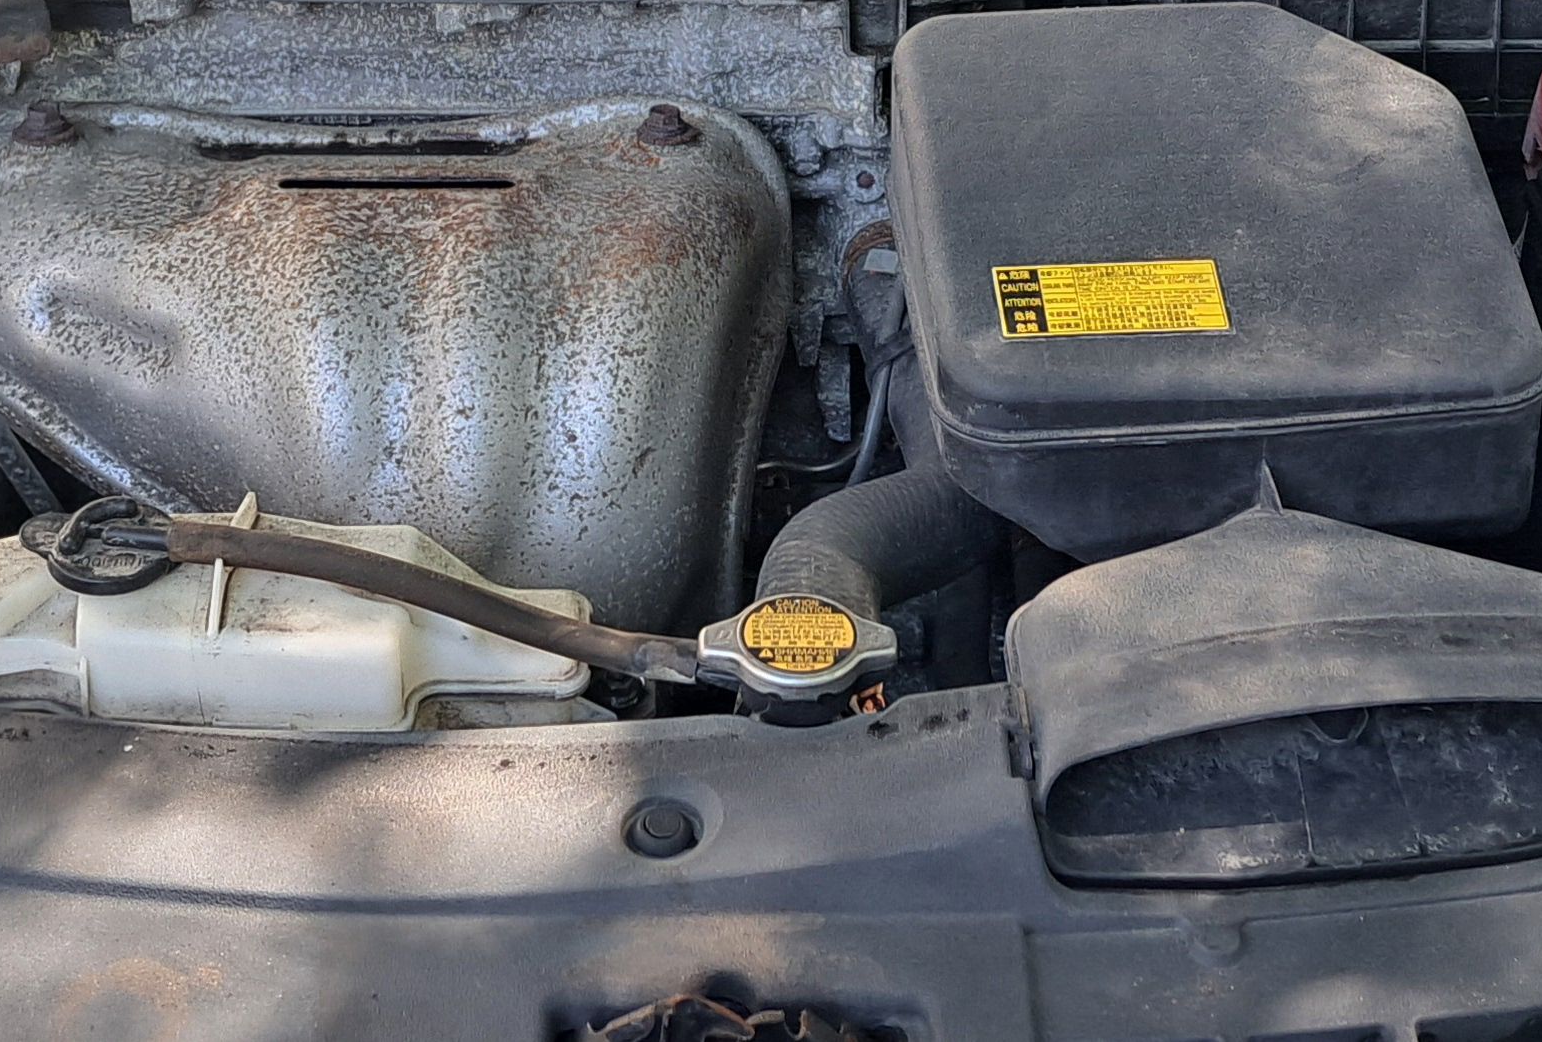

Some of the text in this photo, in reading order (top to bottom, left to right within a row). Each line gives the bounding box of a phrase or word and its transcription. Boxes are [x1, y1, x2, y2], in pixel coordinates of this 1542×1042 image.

[1001, 282, 1039, 293] CAUTION
[1005, 298, 1042, 307] ATTENTION
[775, 598, 820, 607] CAUTION
[776, 605, 832, 614] ATTENTION
